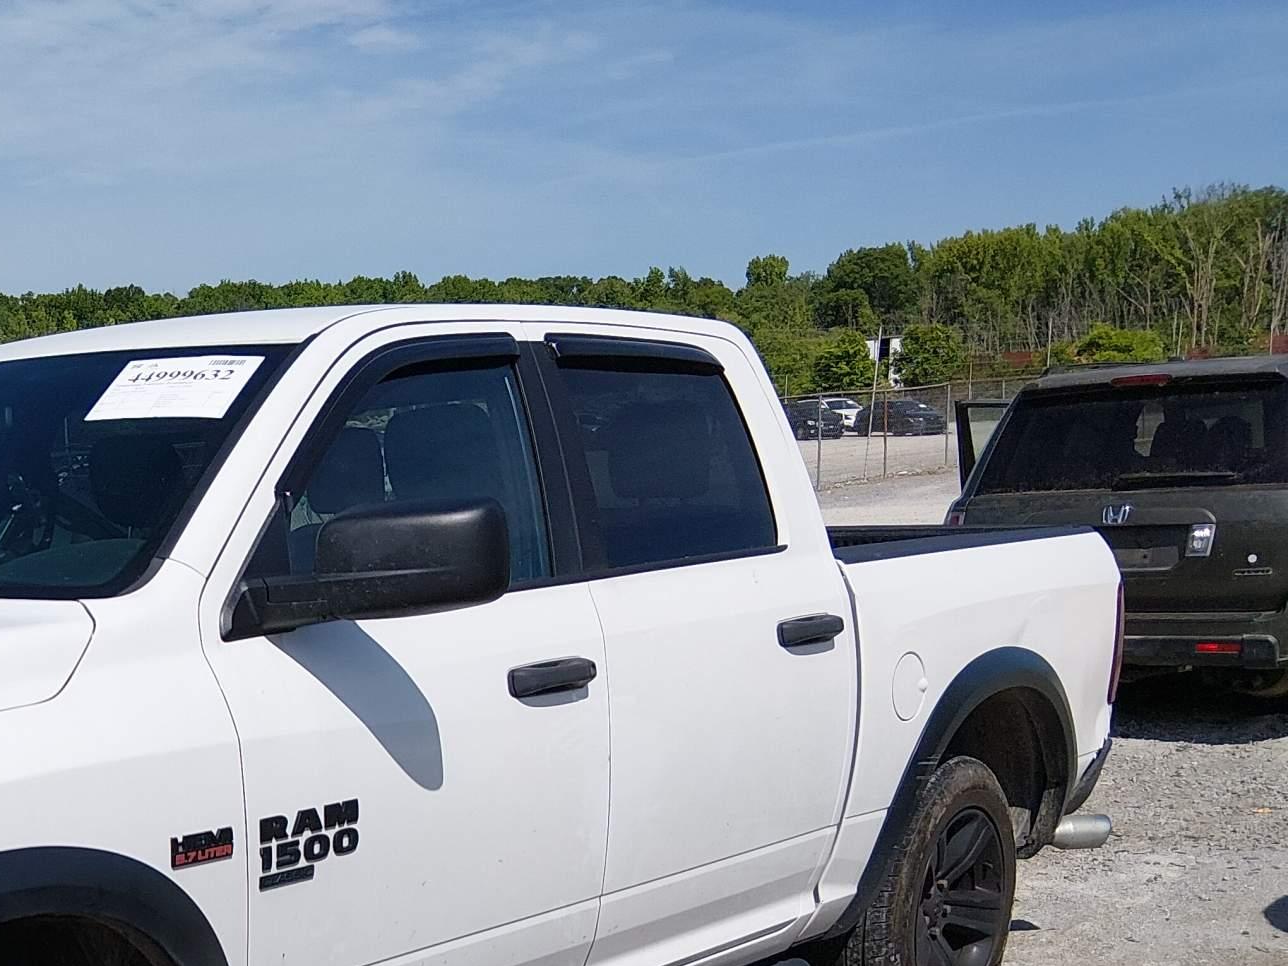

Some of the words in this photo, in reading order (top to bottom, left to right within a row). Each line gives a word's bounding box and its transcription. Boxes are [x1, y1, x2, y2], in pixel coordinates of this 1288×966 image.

[127, 369, 235, 384] 44999632
[259, 798, 360, 844] RAM
[259, 827, 360, 873] 1500
